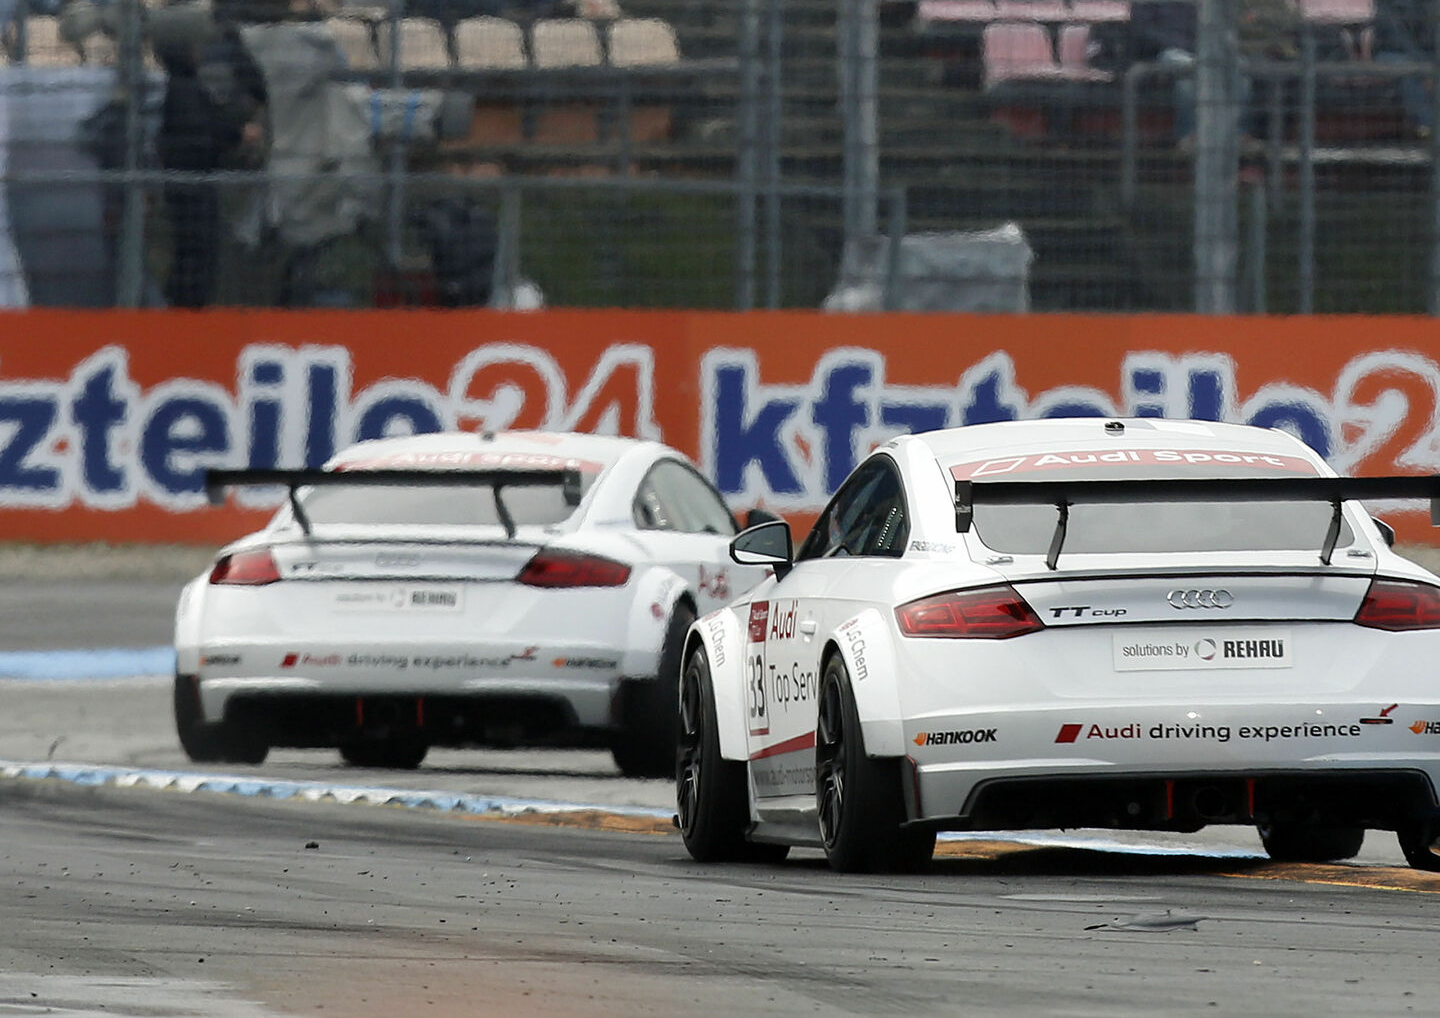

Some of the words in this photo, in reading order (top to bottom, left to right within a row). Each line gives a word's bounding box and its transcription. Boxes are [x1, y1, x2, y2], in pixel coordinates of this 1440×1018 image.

[1033, 450, 1139, 467] Audi
[1153, 450, 1286, 467] Sport
[770, 599, 798, 640] Audi
[1049, 606, 1092, 618] TT
[1092, 608, 1128, 618] cup
[1122, 640, 1173, 657] solutions
[1176, 640, 1190, 659] by
[1223, 639, 1285, 659] REHAU
[851, 639, 869, 682] Chem
[769, 664, 791, 713] Top
[793, 661, 819, 701] Serv
[1086, 722, 1142, 741] Audi
[1149, 721, 1232, 743] driving
[1238, 719, 1362, 743] experience
